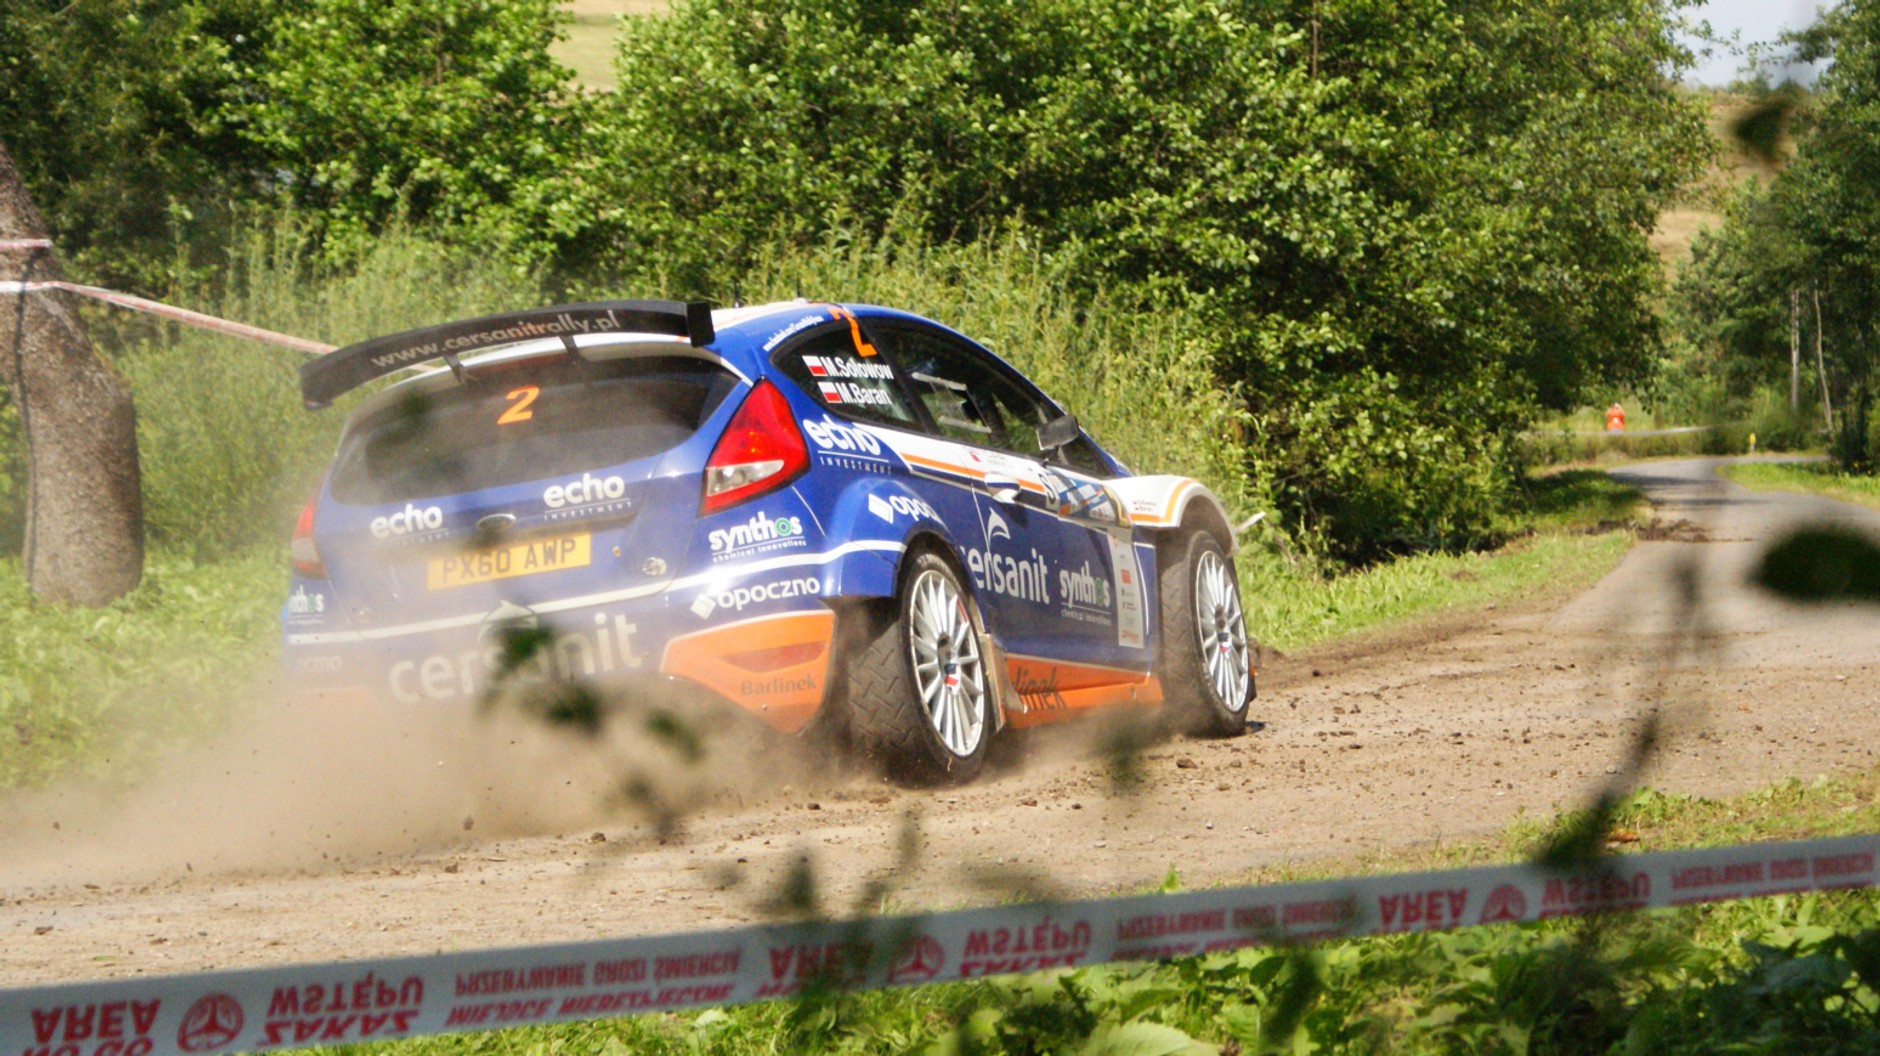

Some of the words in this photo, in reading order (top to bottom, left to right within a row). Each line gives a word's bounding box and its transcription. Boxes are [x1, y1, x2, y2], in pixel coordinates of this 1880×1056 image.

[370, 309, 622, 368] www.cersanitrally.pl
[827, 307, 878, 358] 2
[497, 385, 540, 425] 2
[834, 382, 893, 405] M.Baran
[802, 414, 881, 456] echo
[819, 456, 891, 475] INVESTMENT
[543, 473, 626, 509] echo
[370, 503, 443, 539] echo
[708, 511, 804, 553] synthos
[442, 547, 512, 583] PX60
[524, 538, 577, 570] AWP
[961, 546, 1050, 604] ersanit
[716, 577, 821, 611] opoczno
[1059, 559, 1111, 608] synthos
[741, 673, 817, 695] Barlinek
